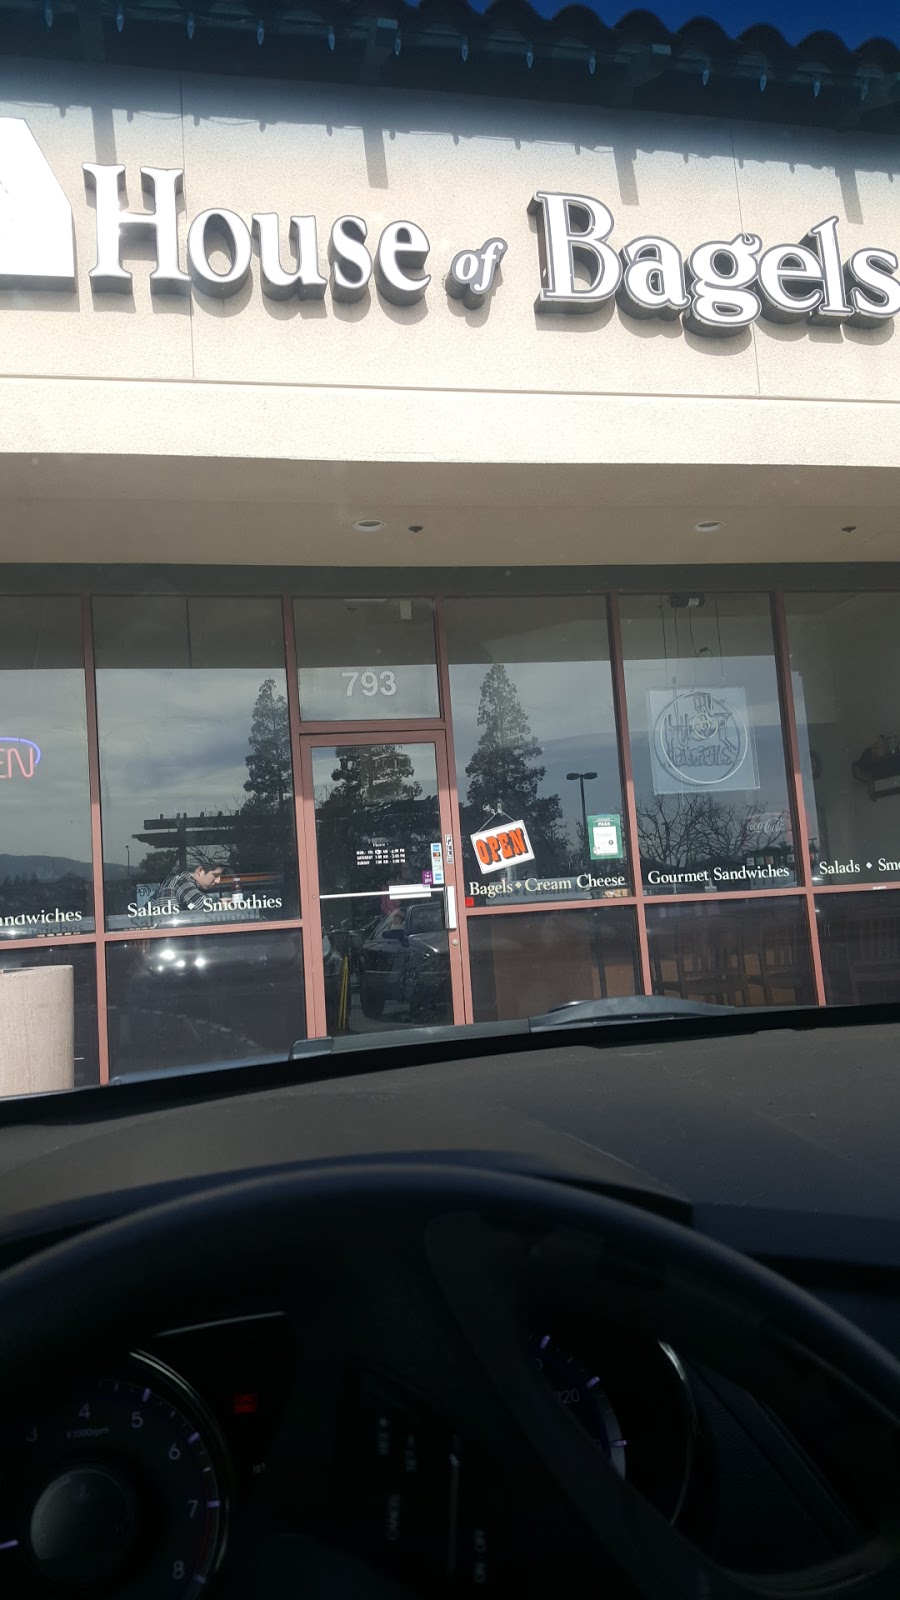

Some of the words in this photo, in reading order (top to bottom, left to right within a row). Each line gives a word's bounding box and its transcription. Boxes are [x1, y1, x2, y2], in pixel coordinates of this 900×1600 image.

[82, 162, 432, 300] House
[449, 237, 508, 297] of
[528, 190, 900, 332] Bagels
[341, 671, 397, 697] 793
[475, 827, 529, 866] OPEN
[647, 868, 710, 885] Gourmet
[713, 864, 790, 881] Sandwiches
[819, 859, 861, 875] Salads
[878, 857, 900, 872] Sm
[469, 879, 513, 898] Bagels
[524, 877, 572, 892] Cream
[576, 873, 626, 889] Cheese
[126, 899, 180, 918] Salads
[203, 893, 283, 913] Smoothies
[78, 1402, 91, 1421] 4
[130, 1411, 144, 1430] 5
[168, 1442, 181, 1461] 6
[187, 1499, 200, 1519] 7
[171, 1560, 185, 1580] 8
